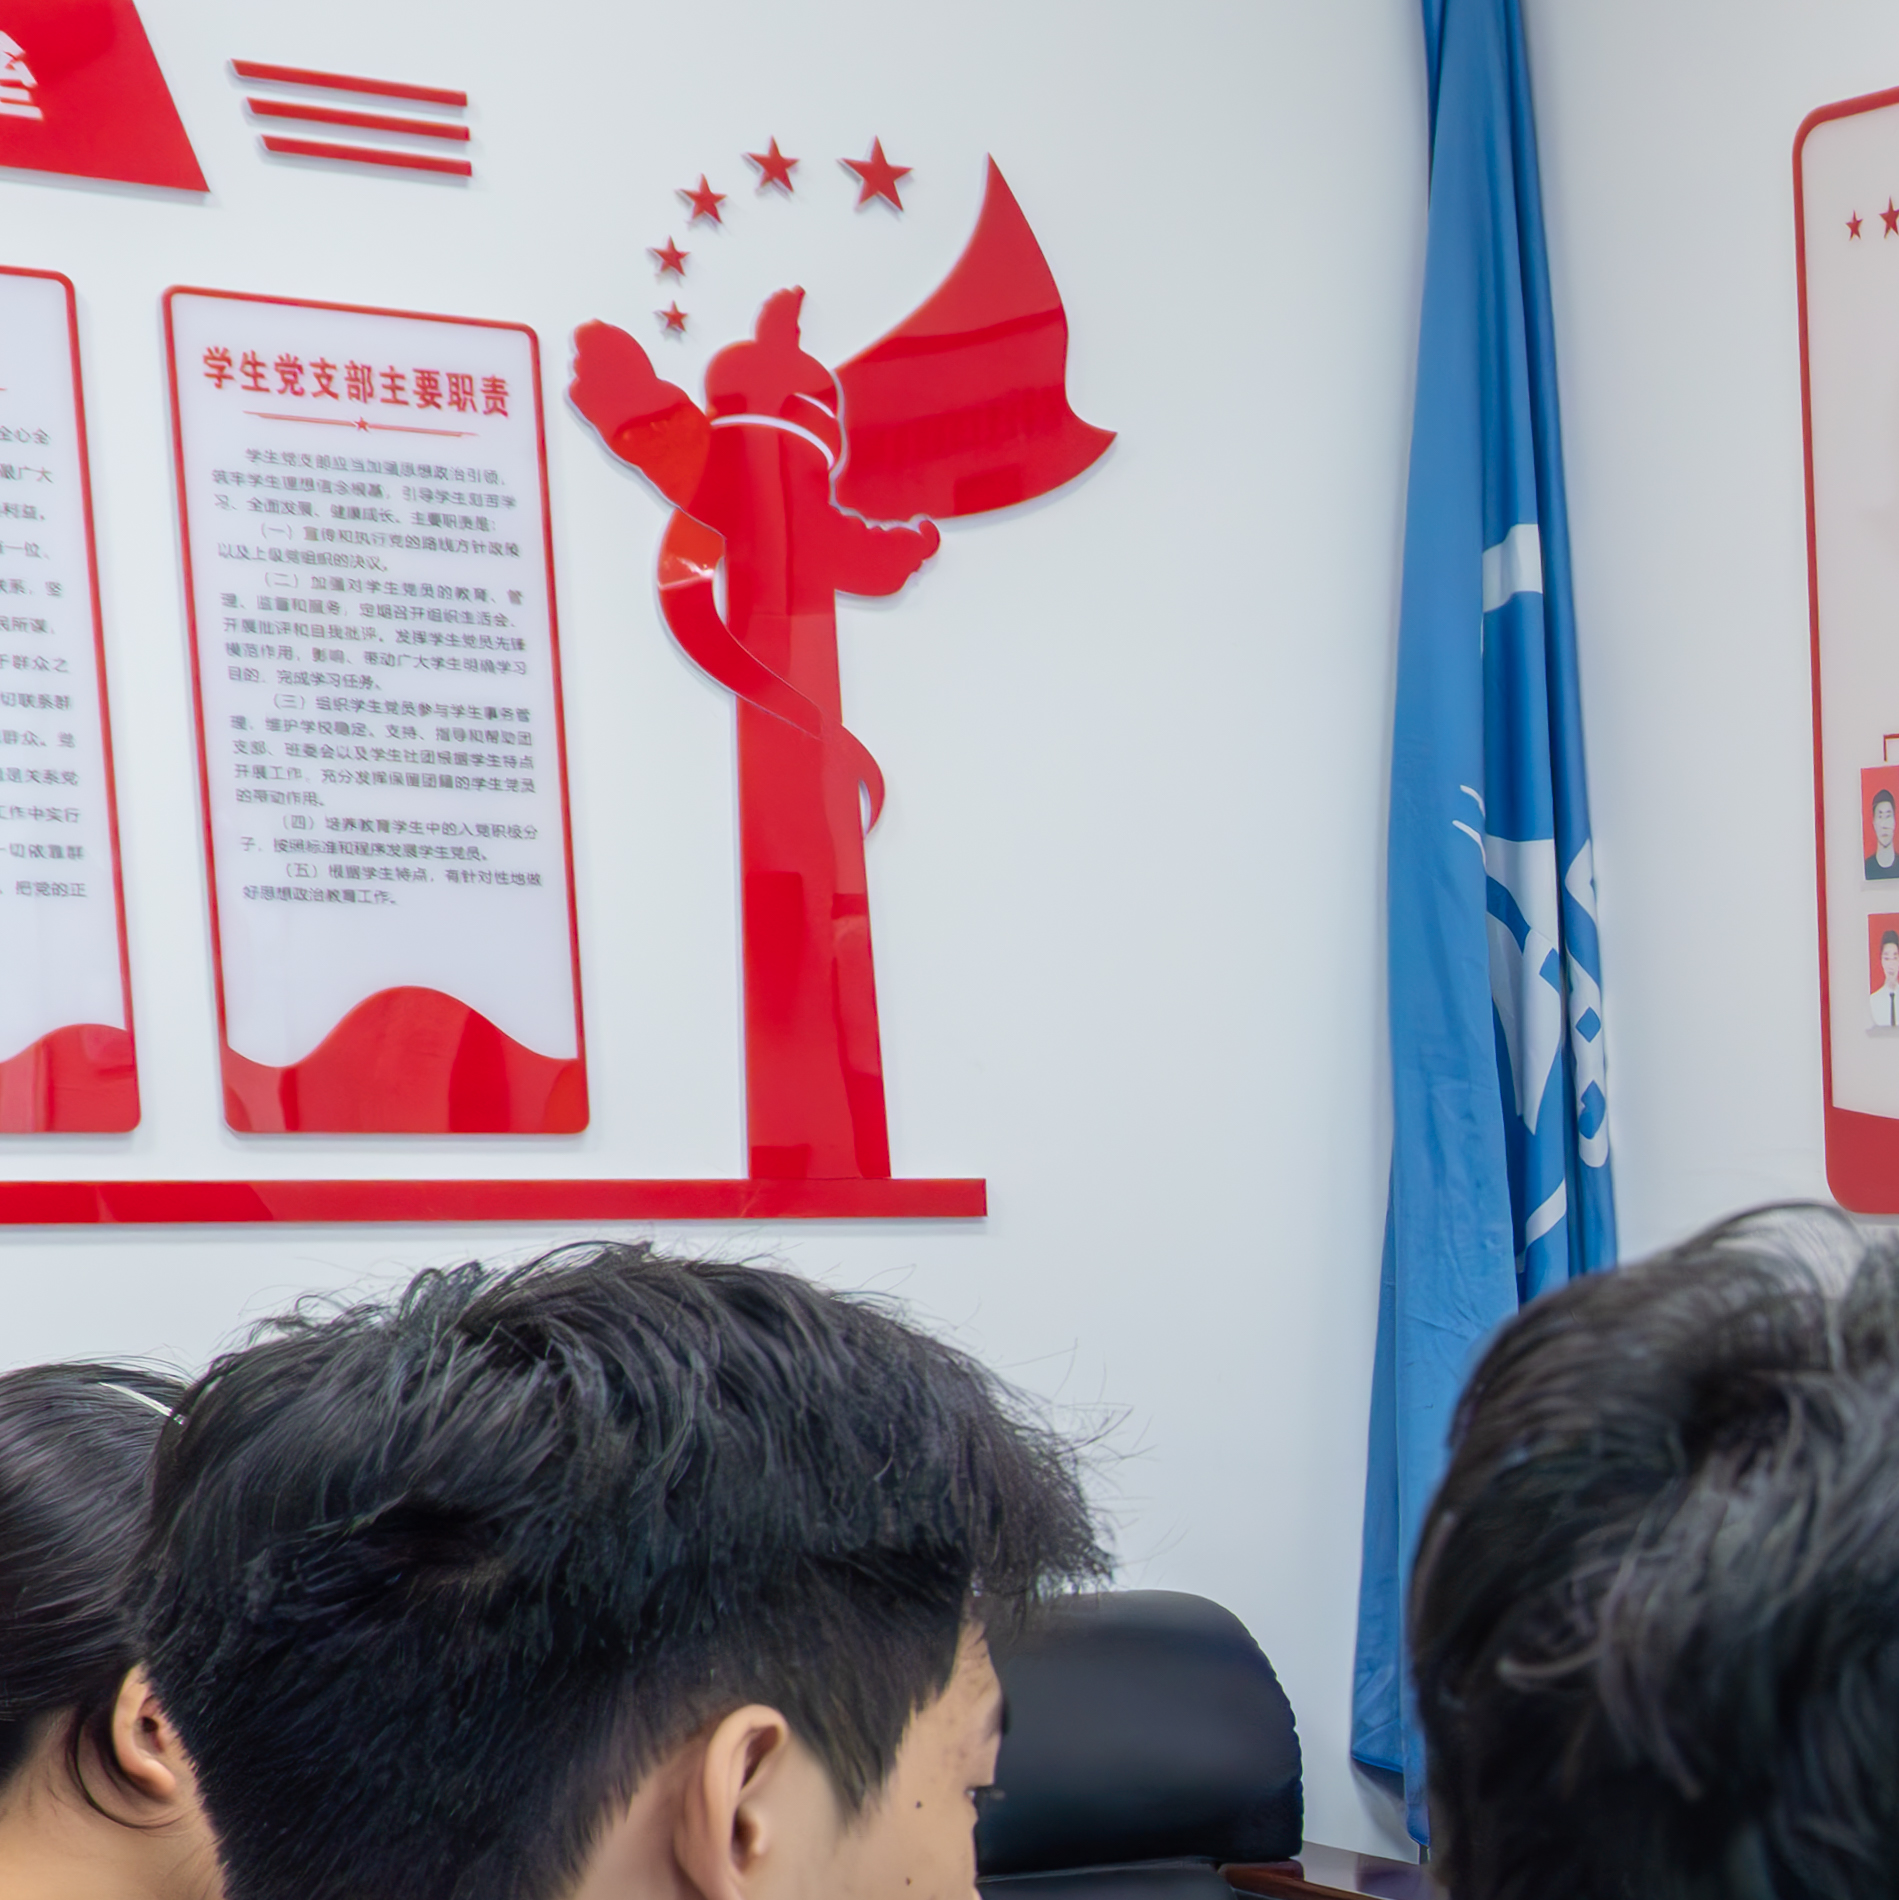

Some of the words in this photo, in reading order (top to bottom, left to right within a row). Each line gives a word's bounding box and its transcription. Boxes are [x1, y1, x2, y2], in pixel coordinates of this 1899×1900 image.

[202, 346, 508, 417] 学生党支部主要职责
